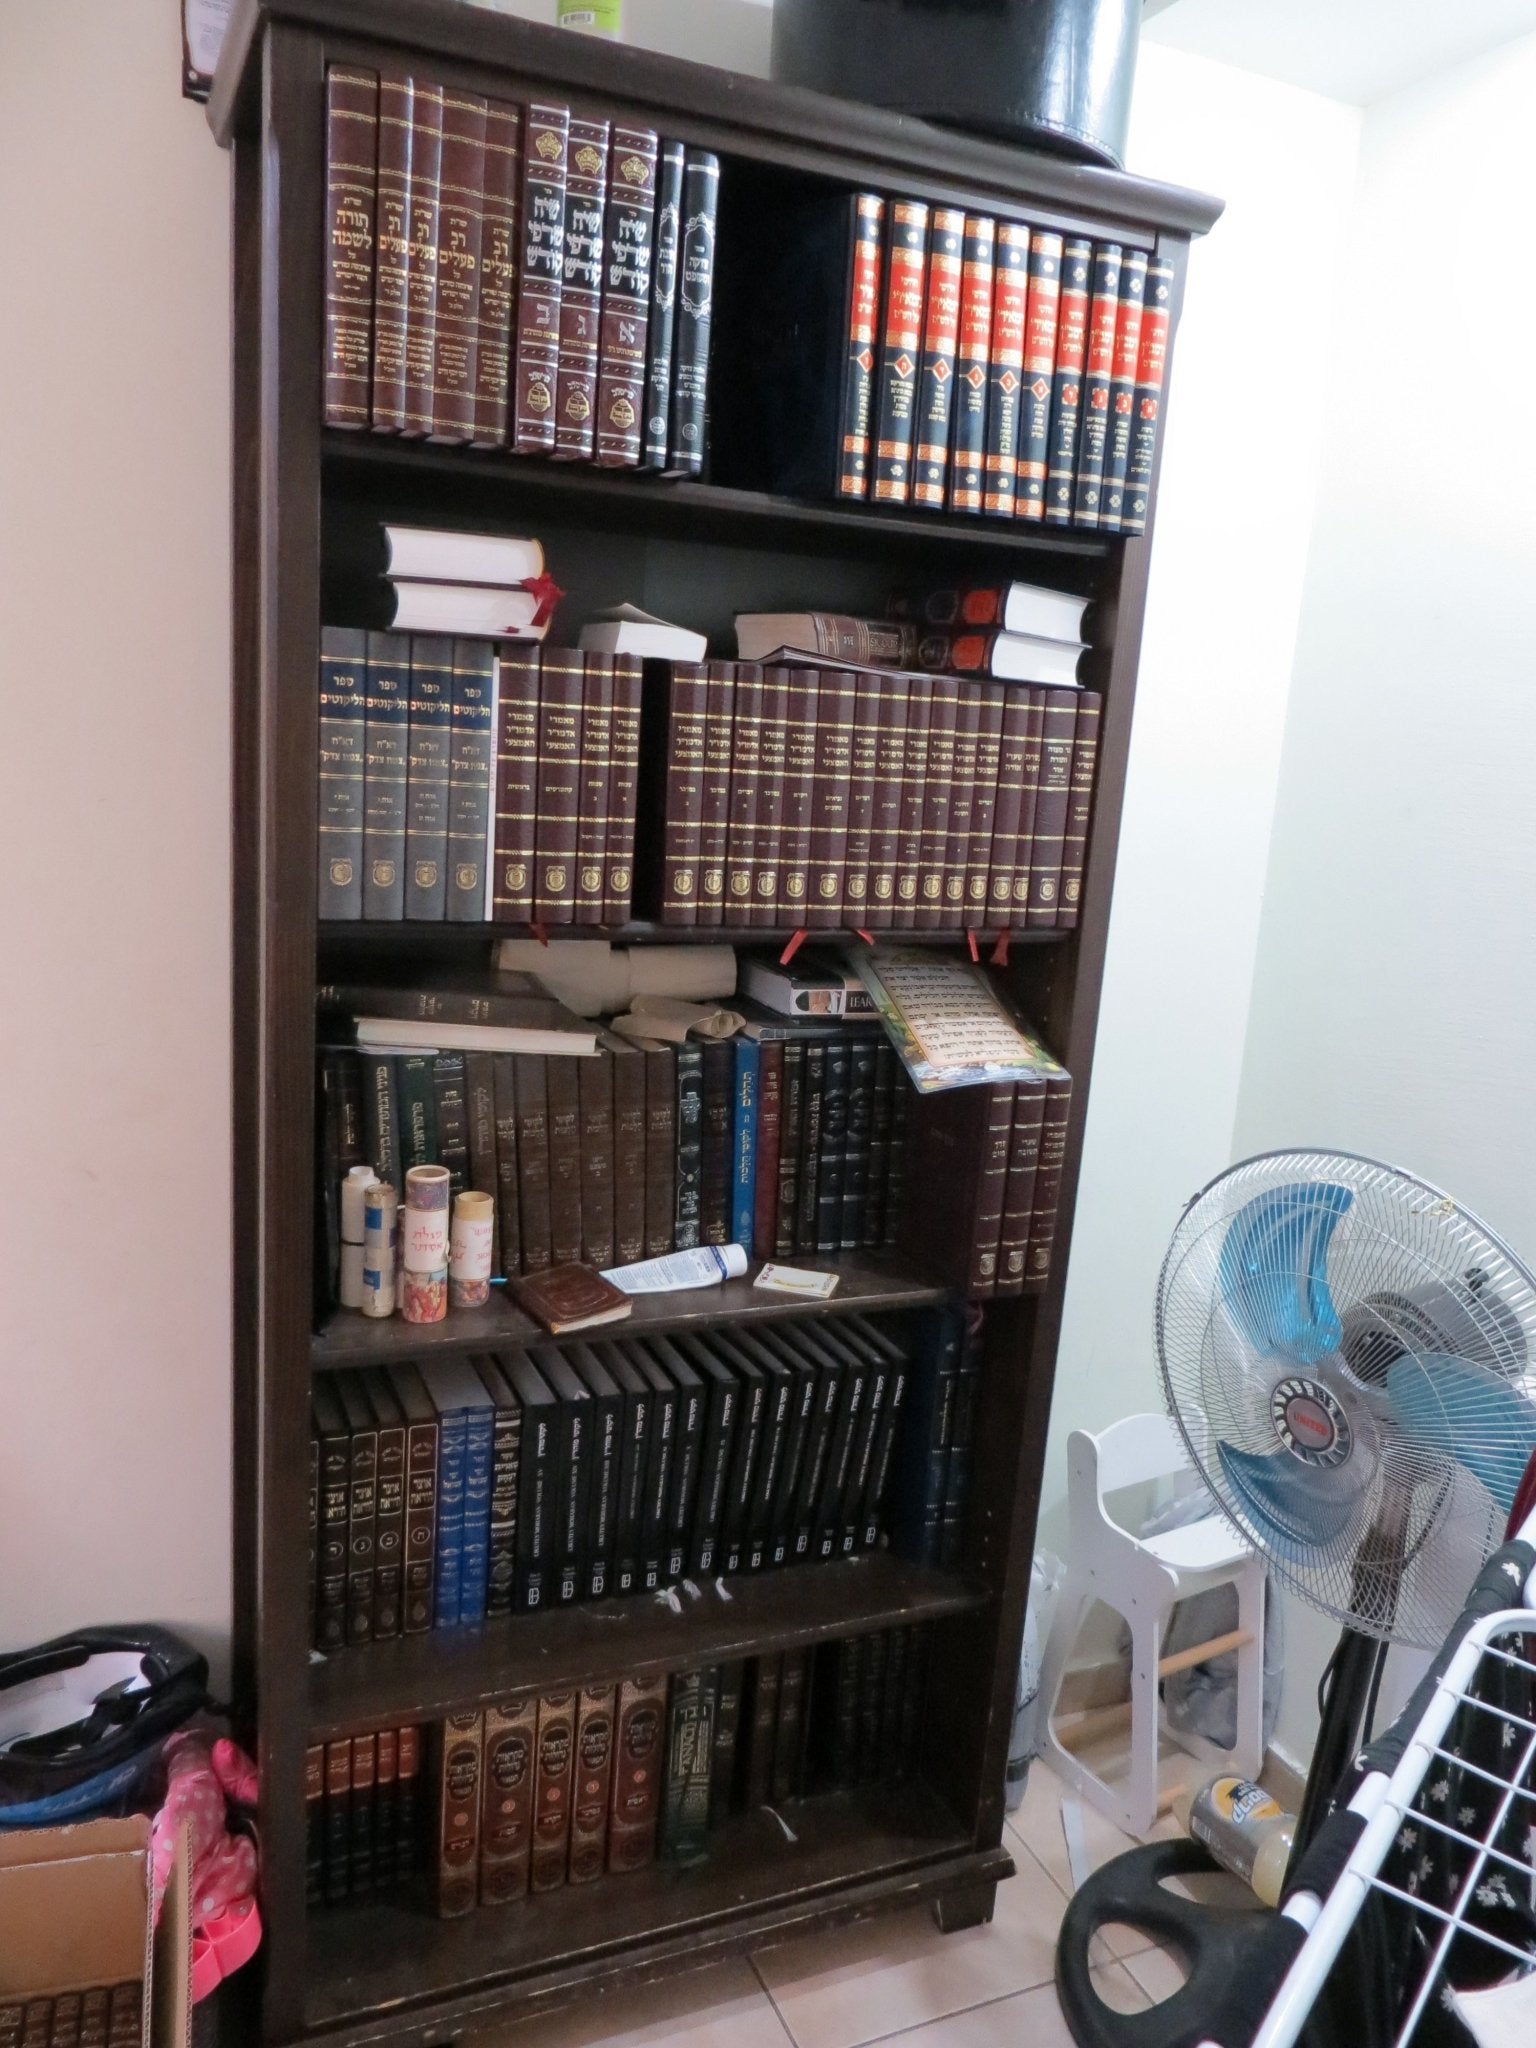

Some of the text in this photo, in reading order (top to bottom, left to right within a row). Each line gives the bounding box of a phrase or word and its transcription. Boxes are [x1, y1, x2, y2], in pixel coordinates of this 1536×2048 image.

[336, 209, 369, 228] תורה
[388, 215, 400, 231] רב
[417, 222, 429, 238] רב
[528, 220, 564, 246] שרפי
[332, 228, 372, 249] לשמה
[379, 231, 408, 253] פעלים
[451, 231, 466, 247] רב
[567, 233, 603, 259] שרפי
[408, 238, 436, 260] פעלים
[494, 240, 508, 256] רב
[612, 241, 649, 267] שרפי
[439, 246, 475, 269] פעלים
[527, 245, 563, 276] קודש
[564, 257, 601, 287] קודש
[610, 265, 649, 296] קודש
[333, 676, 354, 687] ספר
[379, 681, 397, 691] ספר
[422, 683, 440, 694] ספר
[320, 693, 365, 707] הליקוטים
[464, 688, 482, 698] ספר
[366, 697, 408, 711] הליקוטים
[410, 700, 450, 714] הליקוטים
[453, 704, 491, 718] הליקוטים
[508, 713, 534, 721] מאמרי
[550, 716, 575, 725] מאמרי
[588, 718, 609, 727] מאמרי
[618, 719, 638, 728] מאמרי
[678, 726, 702, 734] מאמרי
[711, 727, 730, 735] מאמרי
